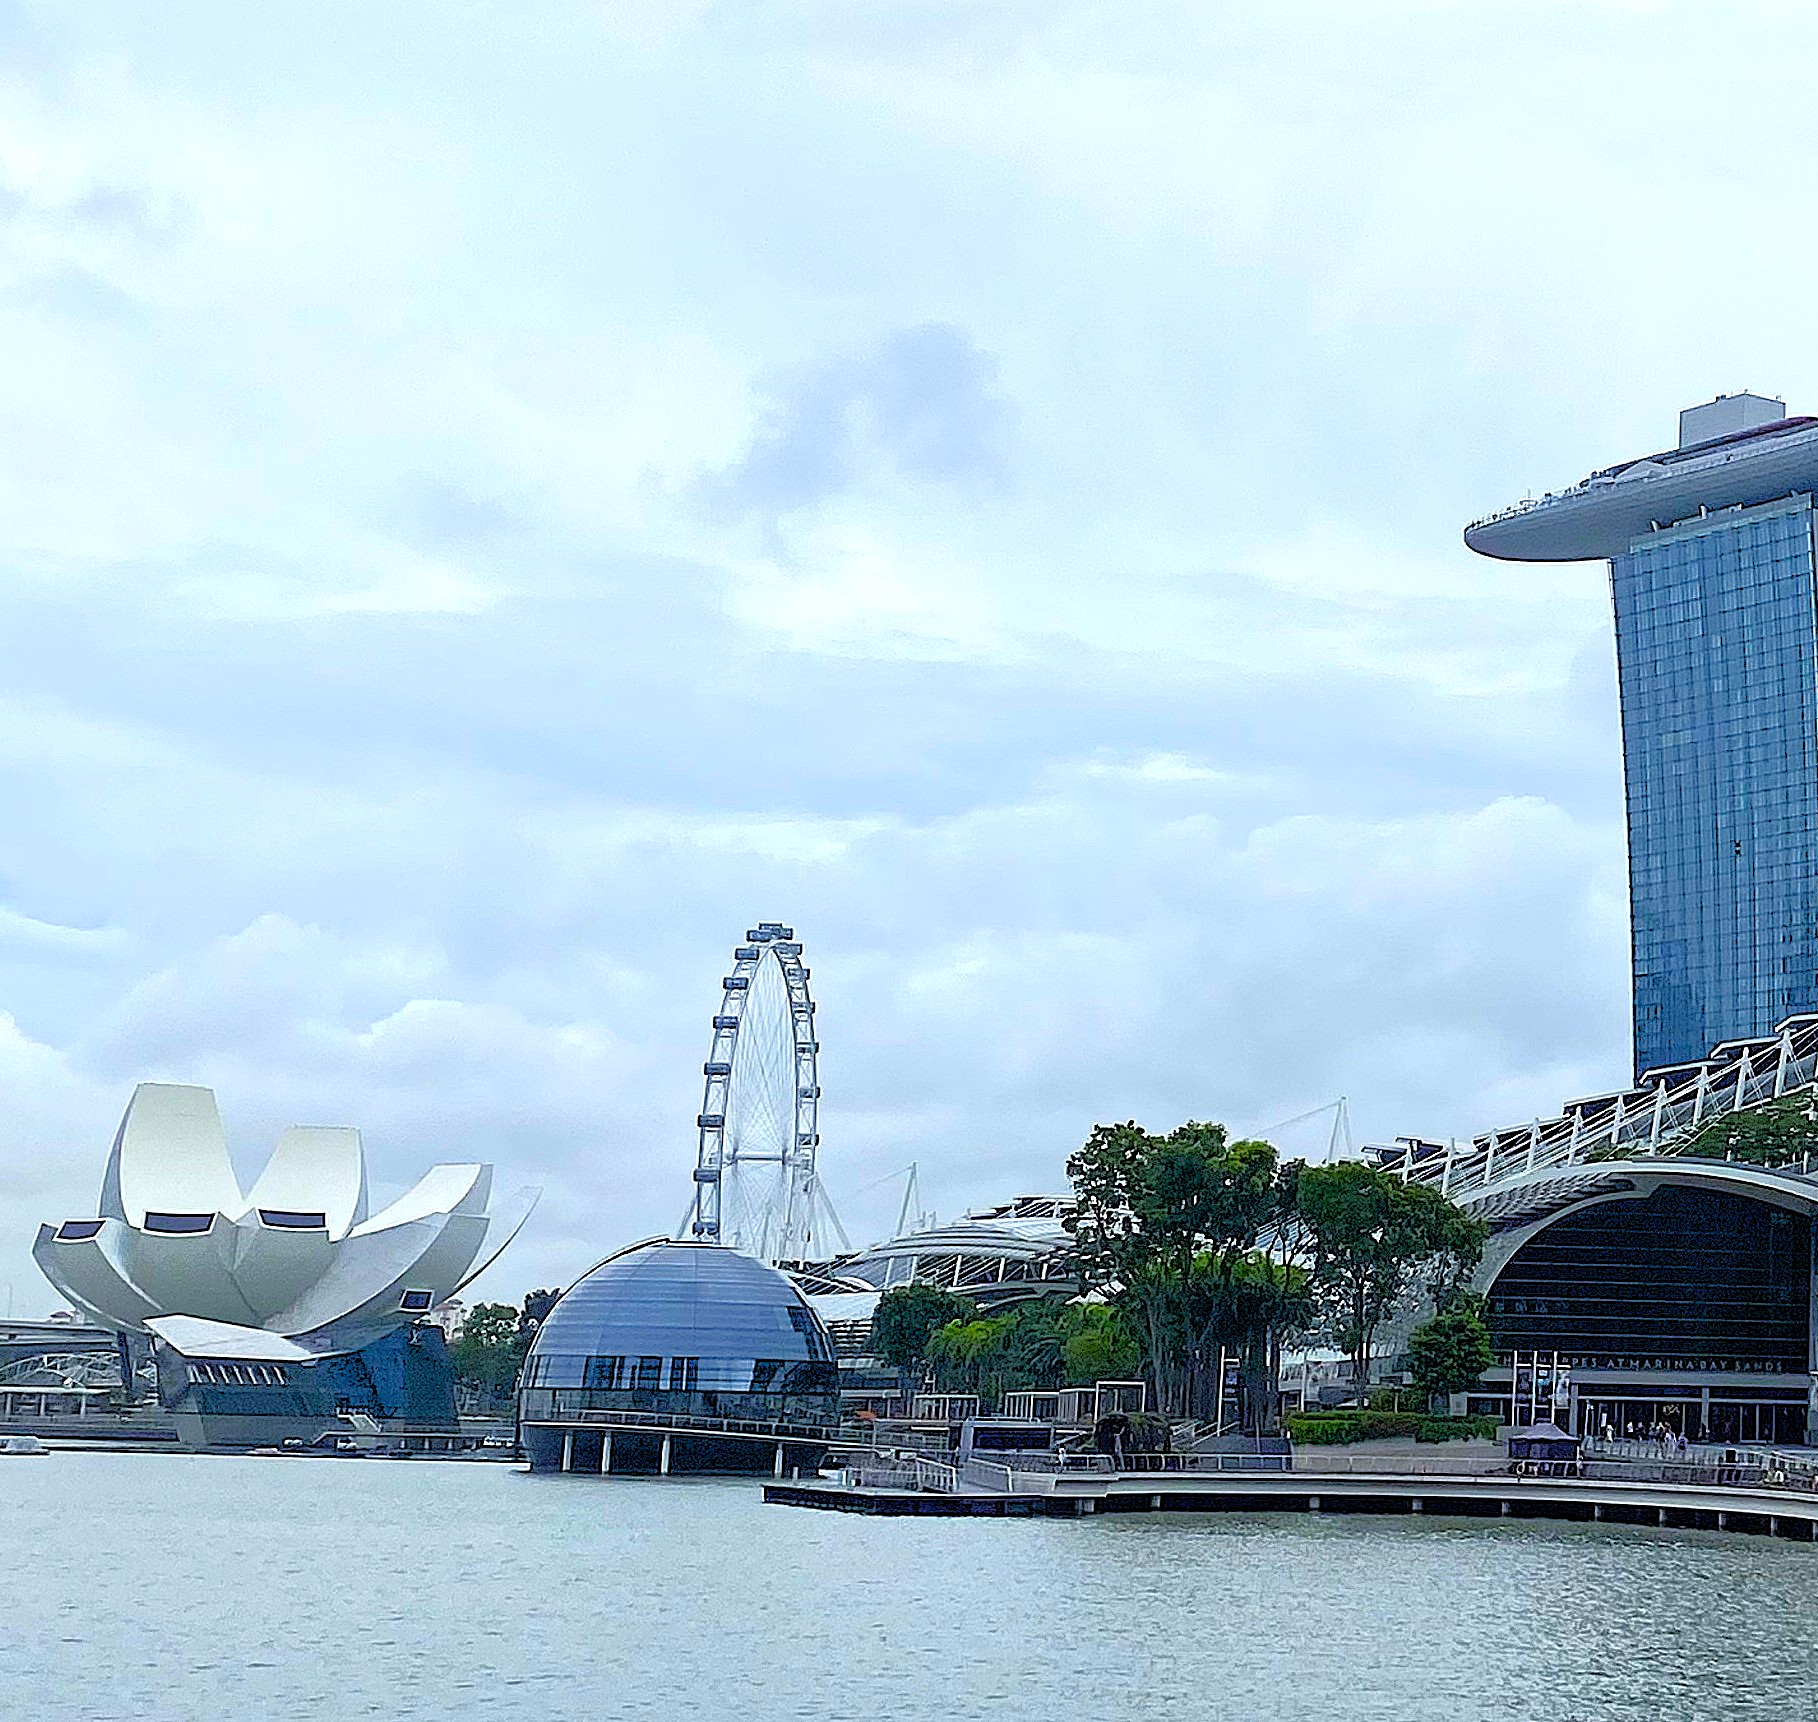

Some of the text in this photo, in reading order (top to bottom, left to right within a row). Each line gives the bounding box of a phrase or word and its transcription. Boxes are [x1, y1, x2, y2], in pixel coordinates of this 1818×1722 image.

[1606, 1357, 1625, 1369] AT
[1629, 1358, 1695, 1370] MARINA
[1700, 1359, 1727, 1370] BAY
[1734, 1360, 1782, 1373] SANDS
